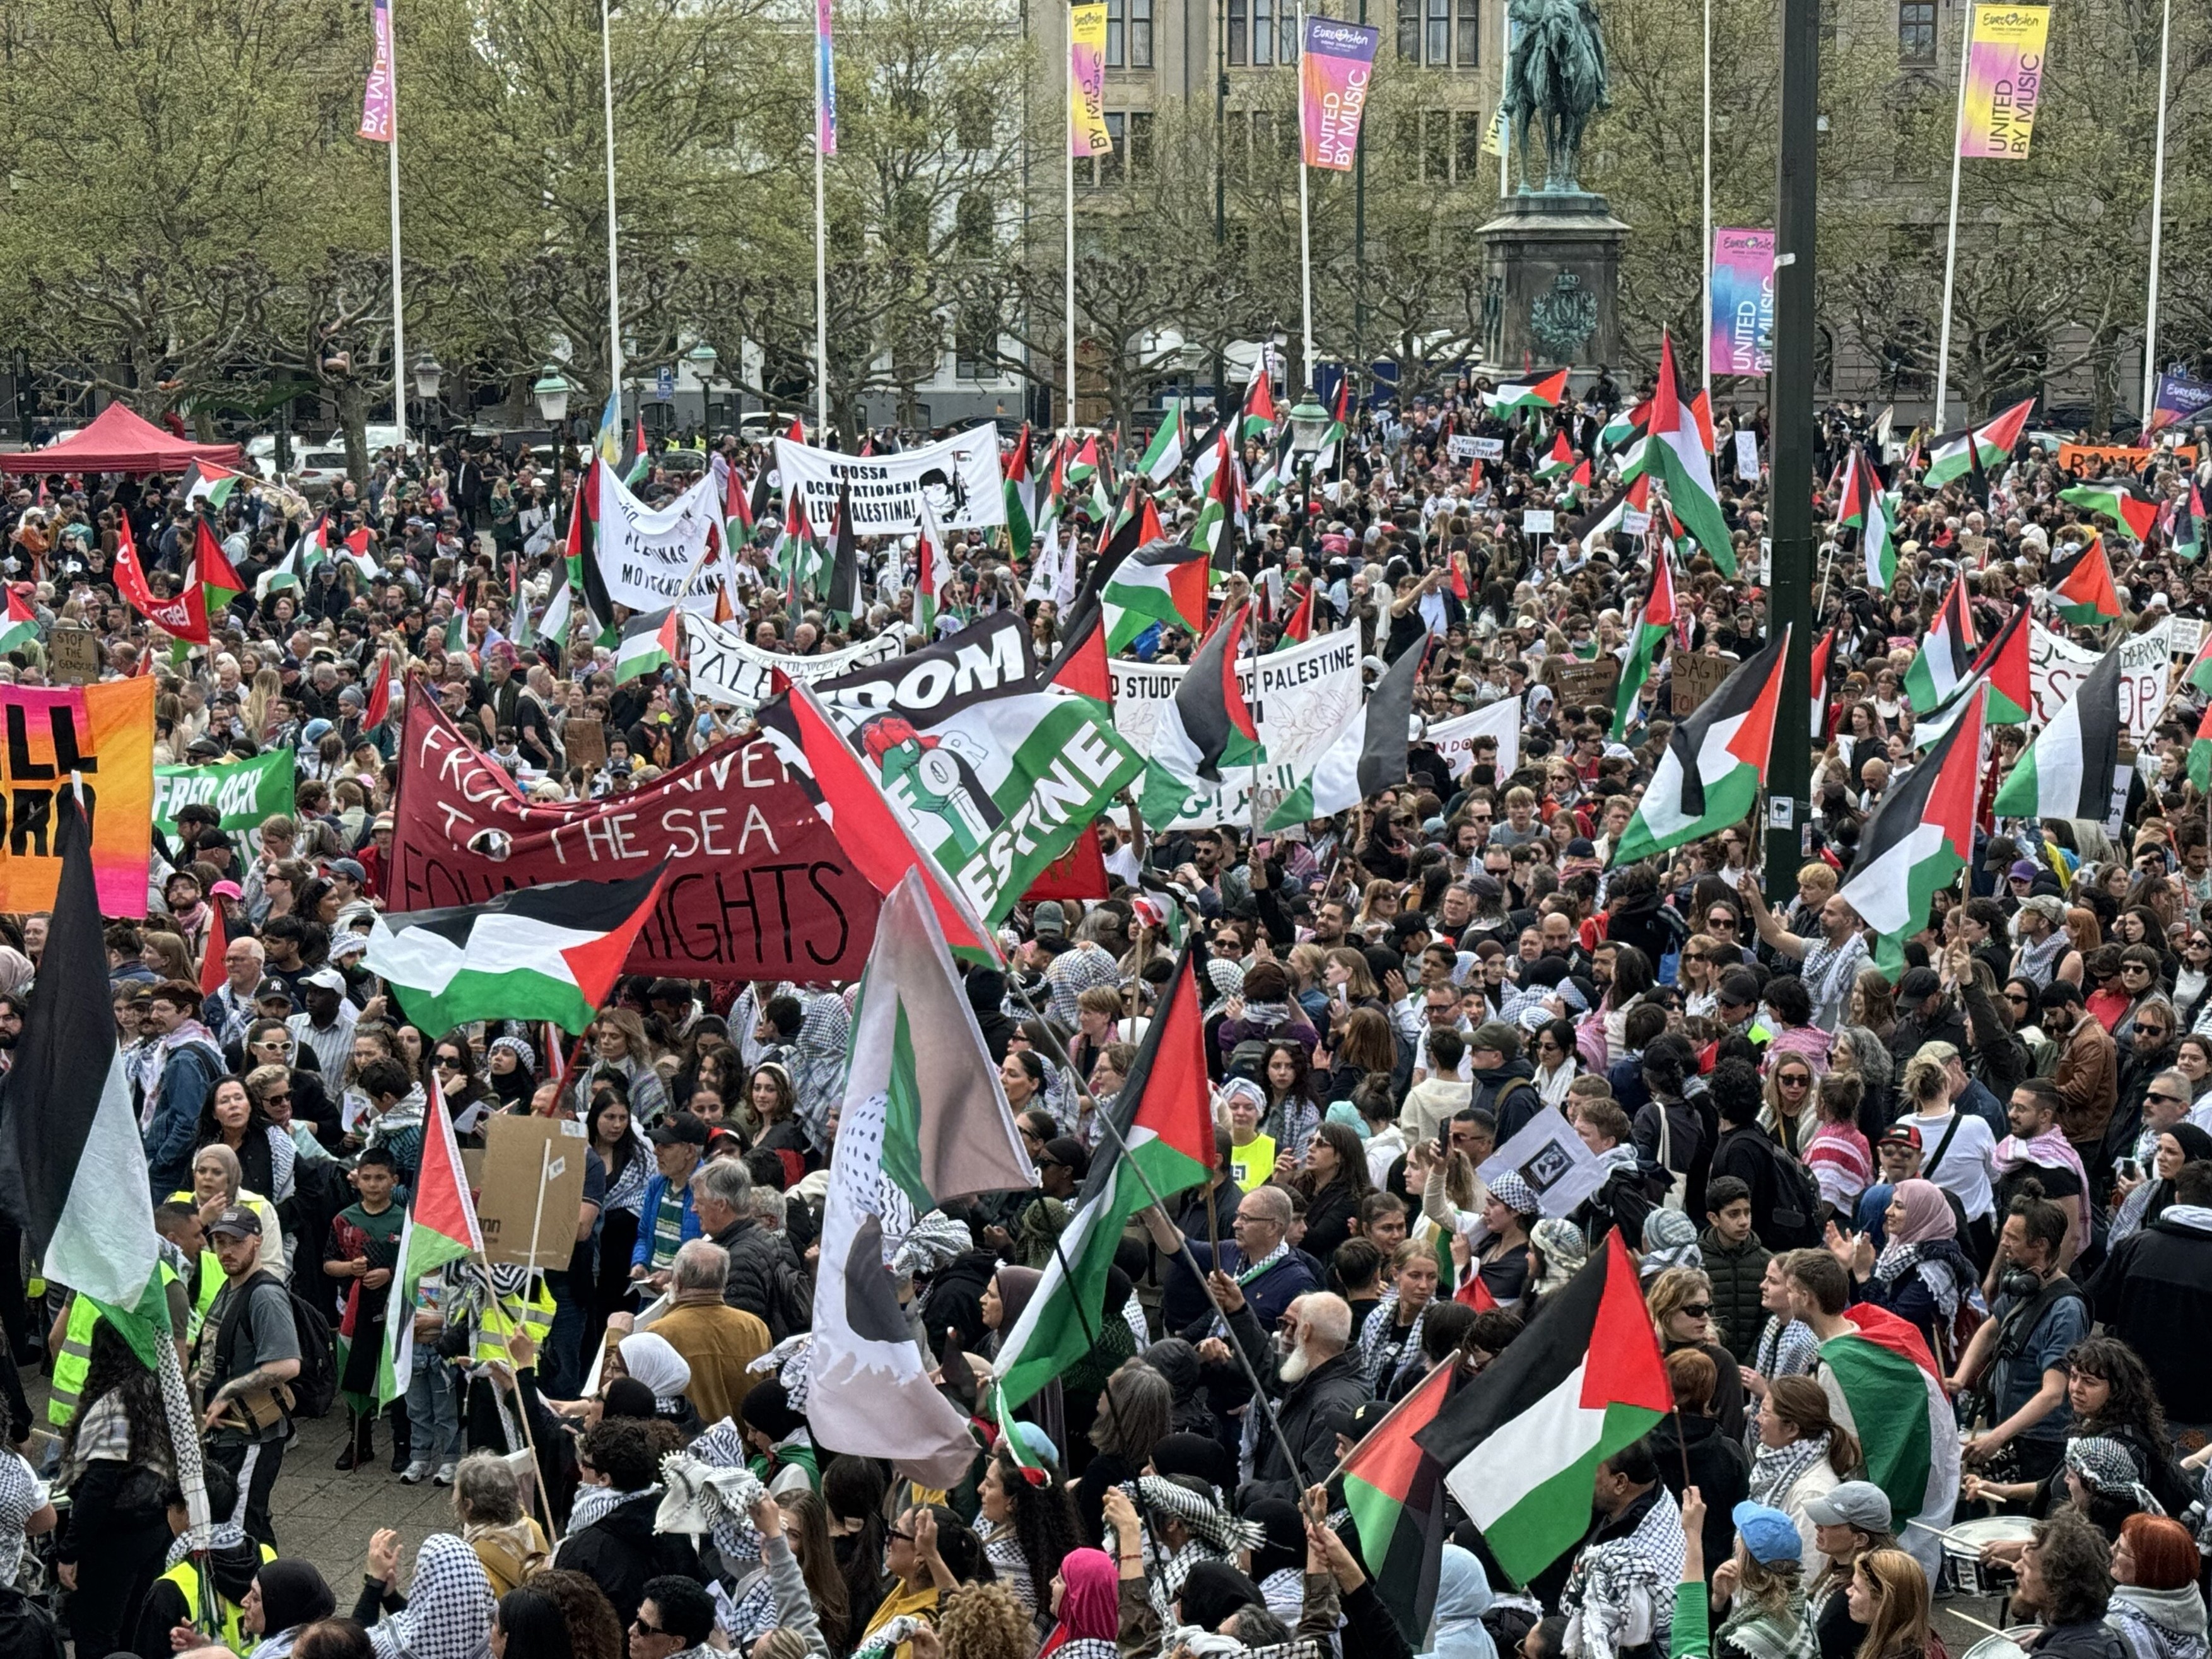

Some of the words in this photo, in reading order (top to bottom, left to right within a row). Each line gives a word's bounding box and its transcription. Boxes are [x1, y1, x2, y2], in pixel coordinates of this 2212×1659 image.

[1337, 69, 1367, 137] MUSIC
[2015, 52, 2040, 124] MUSIC
[1317, 92, 1341, 163] UNITED
[1988, 79, 2014, 153] UNITED
[1089, 127, 1108, 149] BY
[1333, 140, 1353, 166] BY
[2011, 128, 2028, 154] BY
[1732, 300, 1757, 371] UNITED
[661, 368, 670, 381] P
[806, 480, 917, 498] OCKUATIONEN!
[830, 464, 888, 480] KROSSA
[810, 500, 840, 524] LEV
[851, 498, 916, 524] ALESTINA!
[57, 632, 85, 648] STOP
[65, 647, 83, 659] THE
[1126, 676, 1181, 699] STUDE
[1236, 672, 1254, 695] OR
[1263, 643, 1355, 693] PALESTINE
[216, 767, 264, 818] OCH
[436, 800, 513, 862] TO
[551, 812, 650, 864] THE
[662, 804, 780, 859] SEA
[956, 720, 1126, 922] ESTINE
